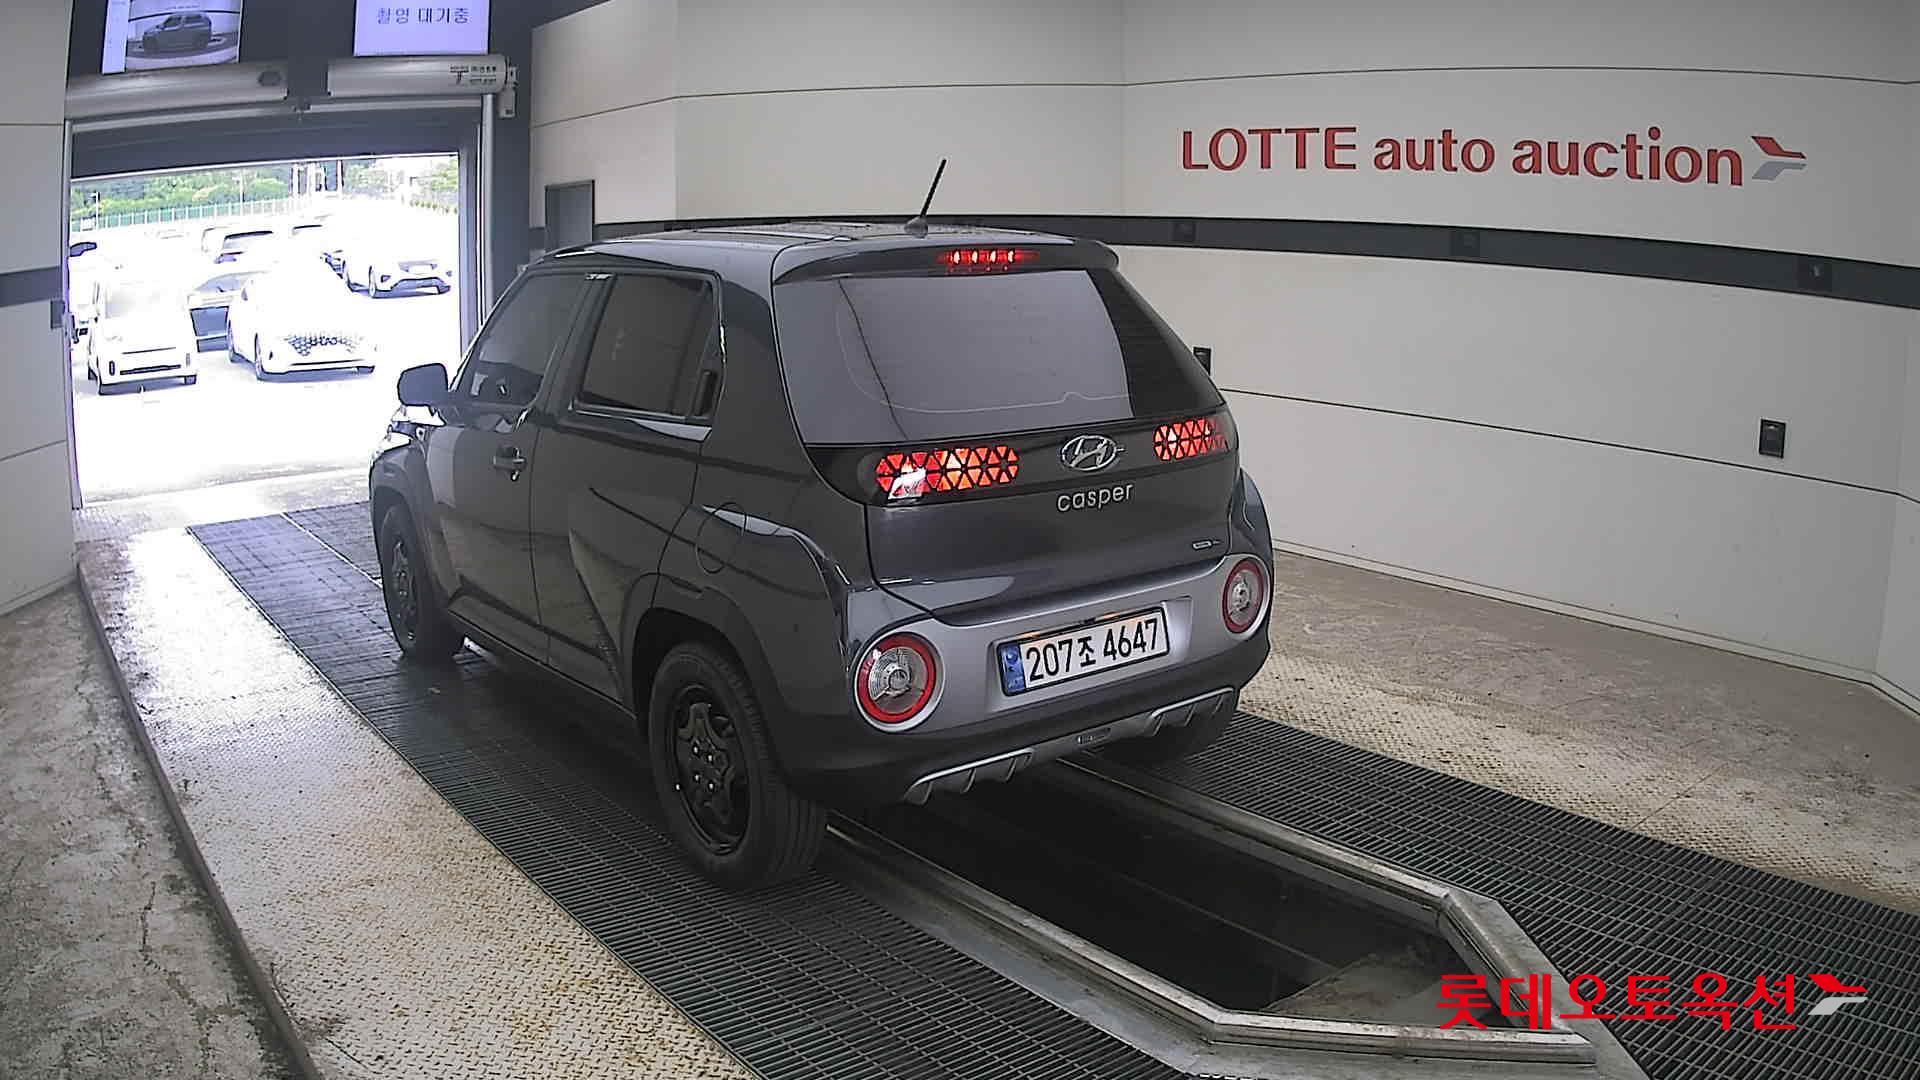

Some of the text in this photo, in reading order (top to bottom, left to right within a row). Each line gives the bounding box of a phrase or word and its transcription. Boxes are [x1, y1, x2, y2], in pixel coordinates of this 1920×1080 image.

[418, 7, 471, 25] 대기중
[1182, 126, 1744, 187] LOTTE auto auction
[1057, 483, 1134, 512] casper
[1025, 617, 1158, 682] 207조 4647
